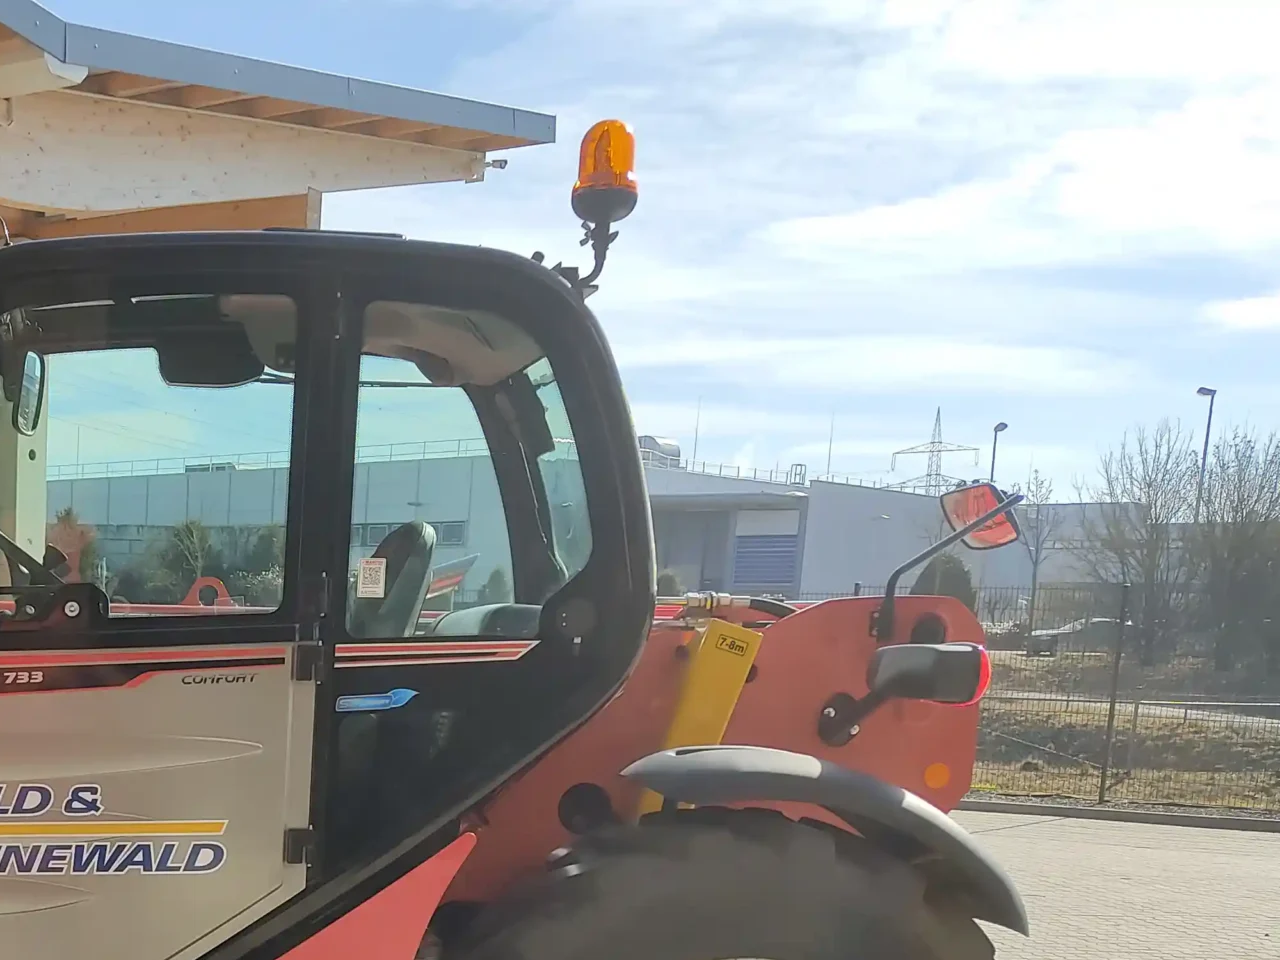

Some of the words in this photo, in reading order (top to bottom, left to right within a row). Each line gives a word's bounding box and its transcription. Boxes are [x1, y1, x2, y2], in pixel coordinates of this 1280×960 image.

[719, 636, 745, 654] 7-8m
[3, 671, 44, 684] 733
[181, 671, 260, 685] COMFORT
[62, 784, 105, 816] &
